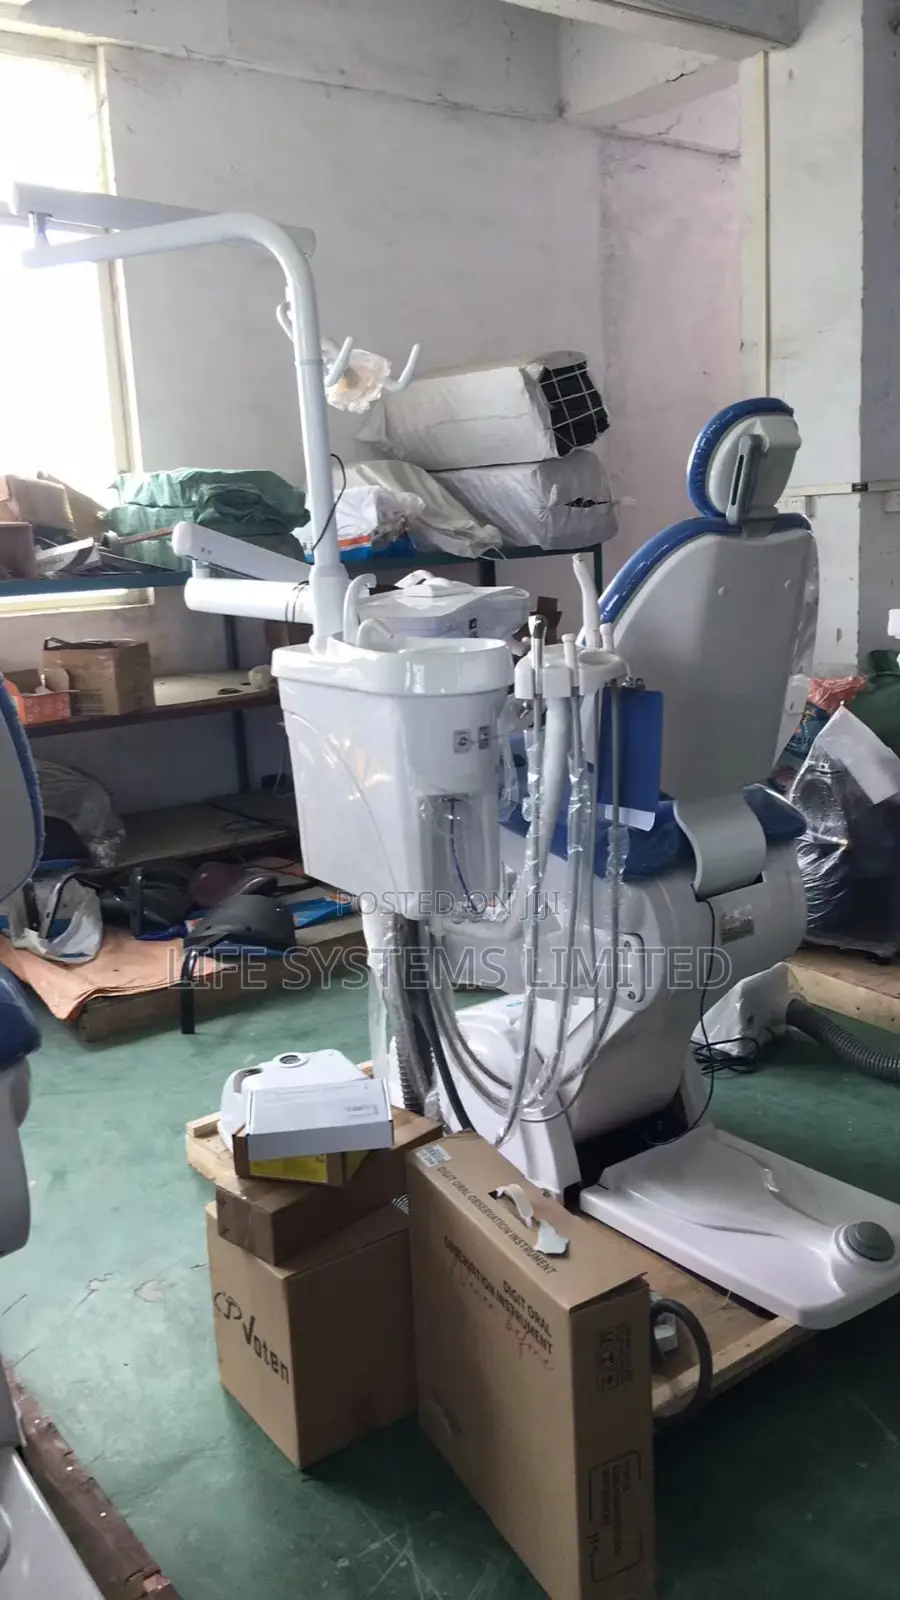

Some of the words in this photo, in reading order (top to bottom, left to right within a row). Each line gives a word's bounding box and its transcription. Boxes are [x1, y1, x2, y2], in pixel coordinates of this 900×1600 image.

[509, 1231, 558, 1275] INSTRUMENT
[496, 1290, 553, 1355] INSTRUMENT
[527, 1305, 552, 1338] ORAL
[242, 1314, 289, 1385] Voten
